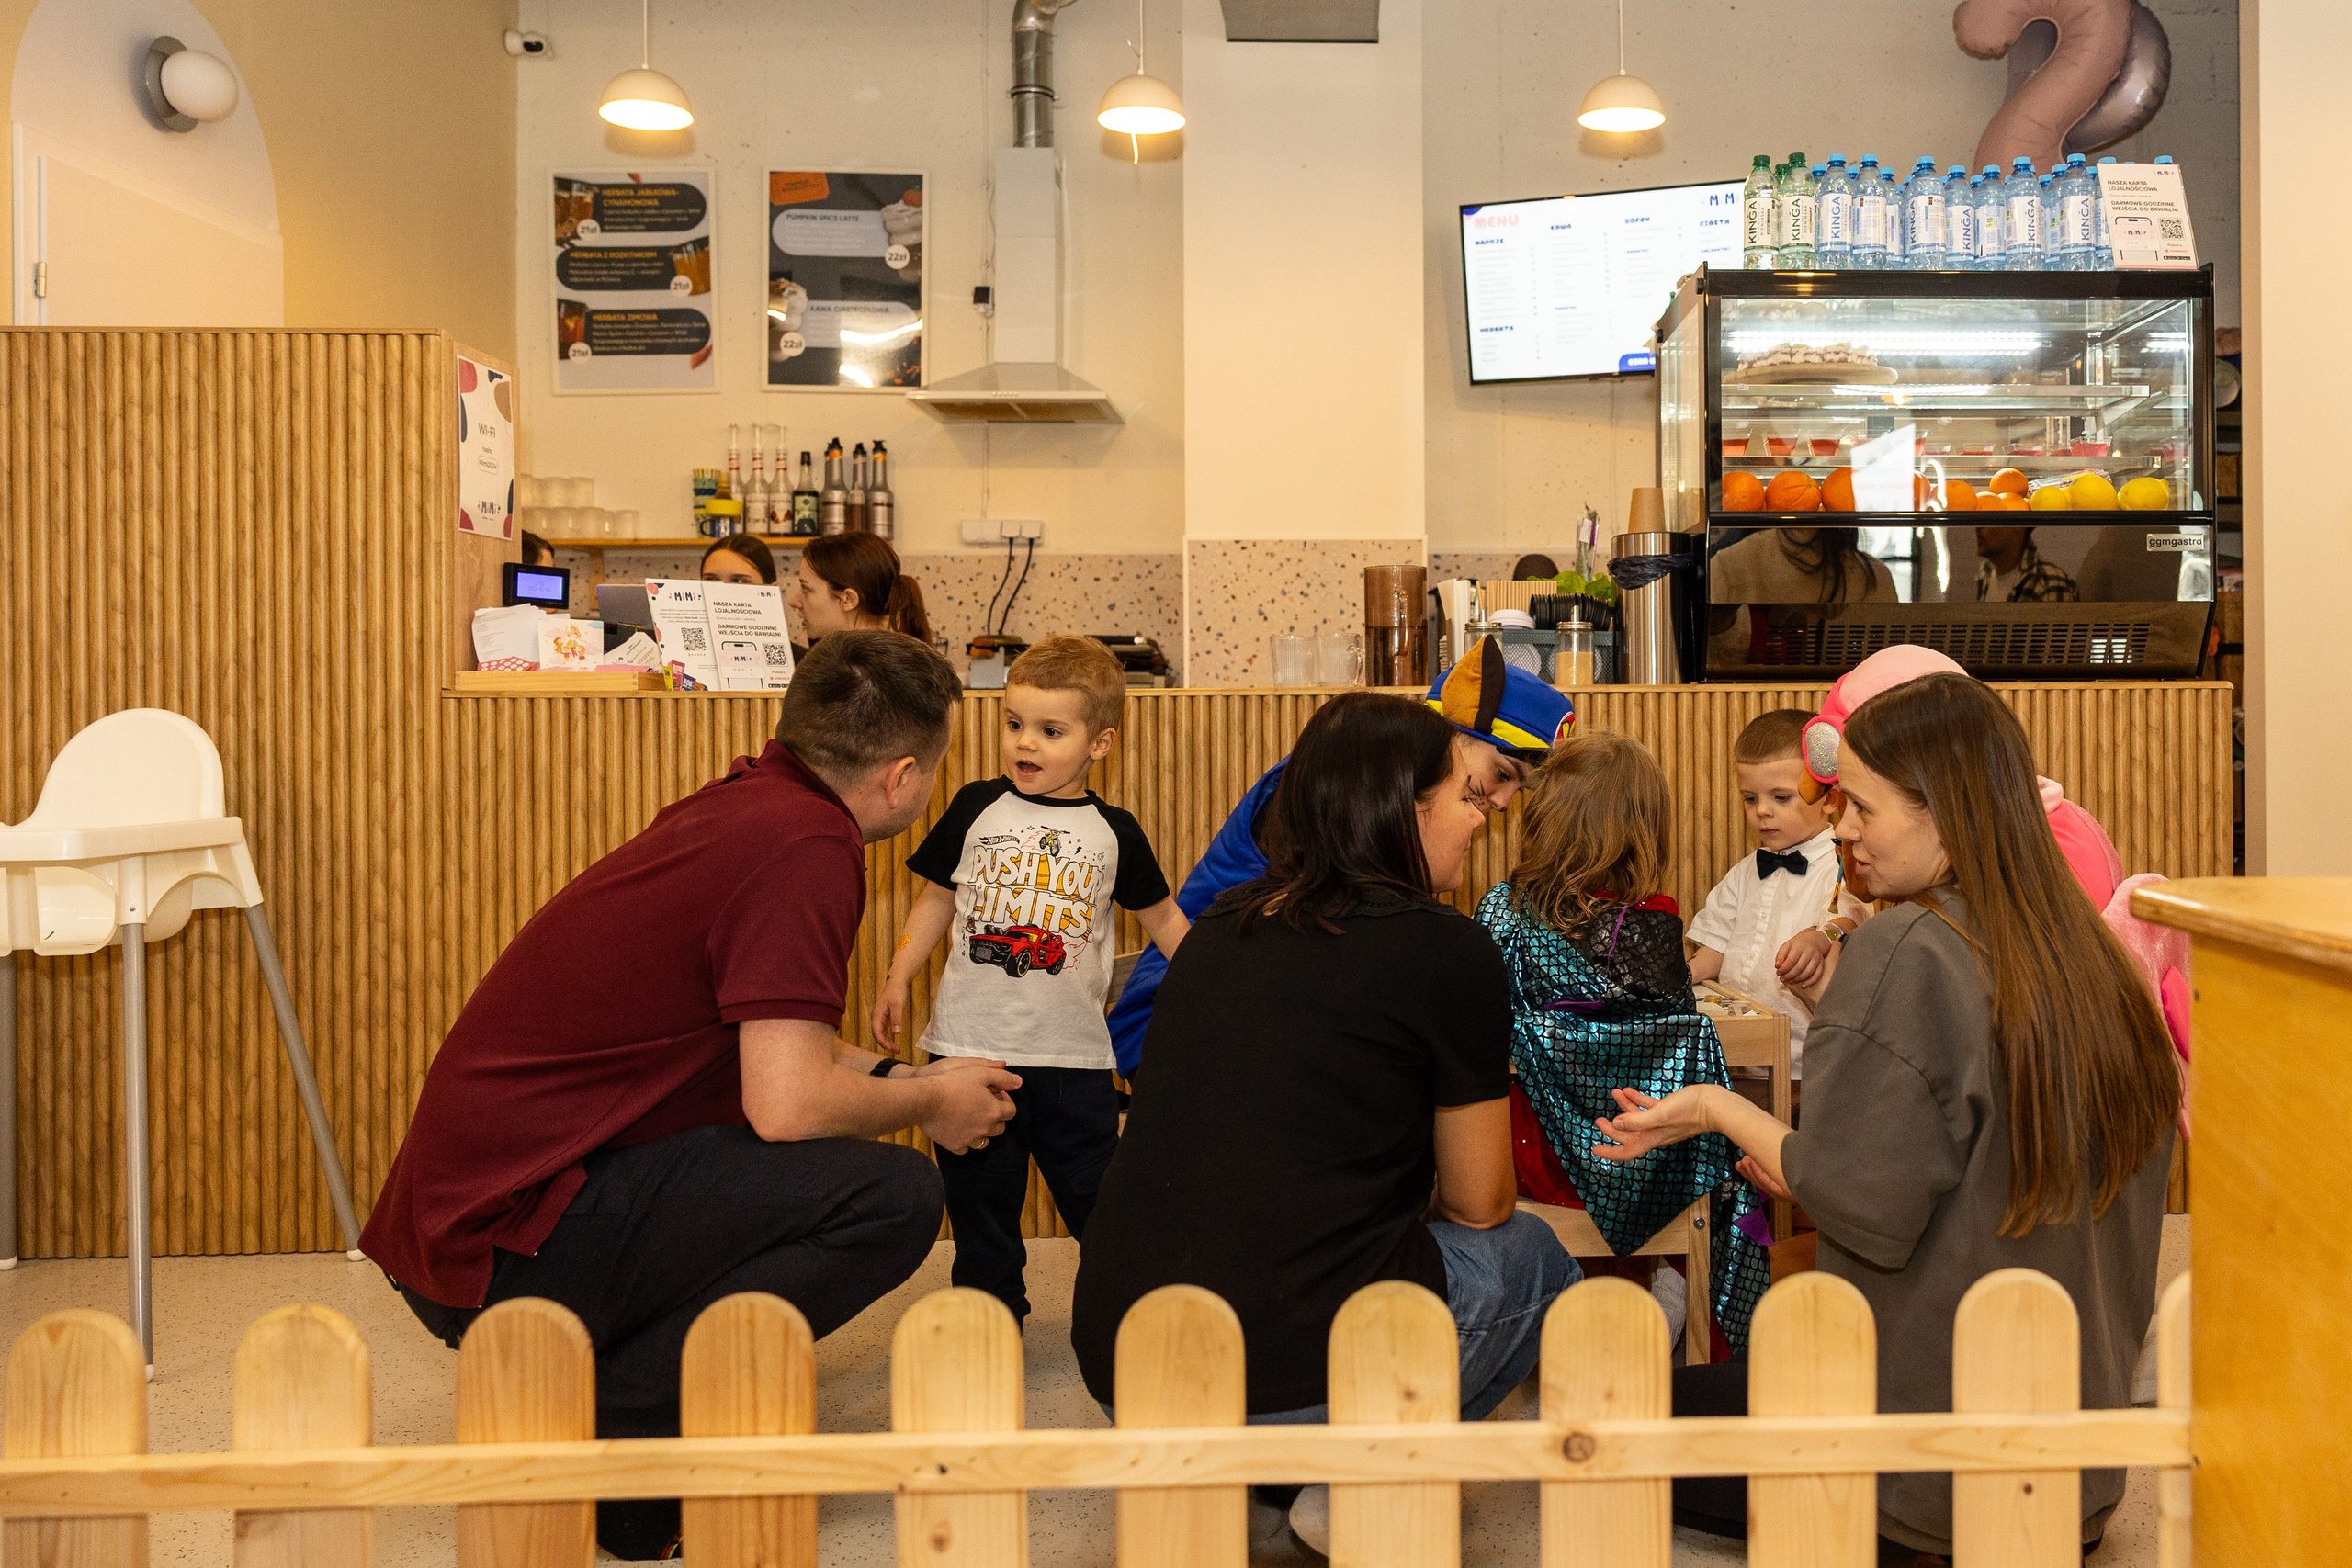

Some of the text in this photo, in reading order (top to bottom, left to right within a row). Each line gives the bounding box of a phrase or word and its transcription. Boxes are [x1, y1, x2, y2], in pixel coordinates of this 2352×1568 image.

[1475, 214, 1520, 230] MENU
[1830, 196, 1841, 239] KINGA
[888, 253, 908, 261] 22zł
[592, 313, 626, 321] HERBATA
[783, 340, 802, 348] 22zł
[478, 423, 496, 438] WI-FI
[2149, 538, 2202, 547] ggmgastro
[967, 845, 1041, 886] PUSH
